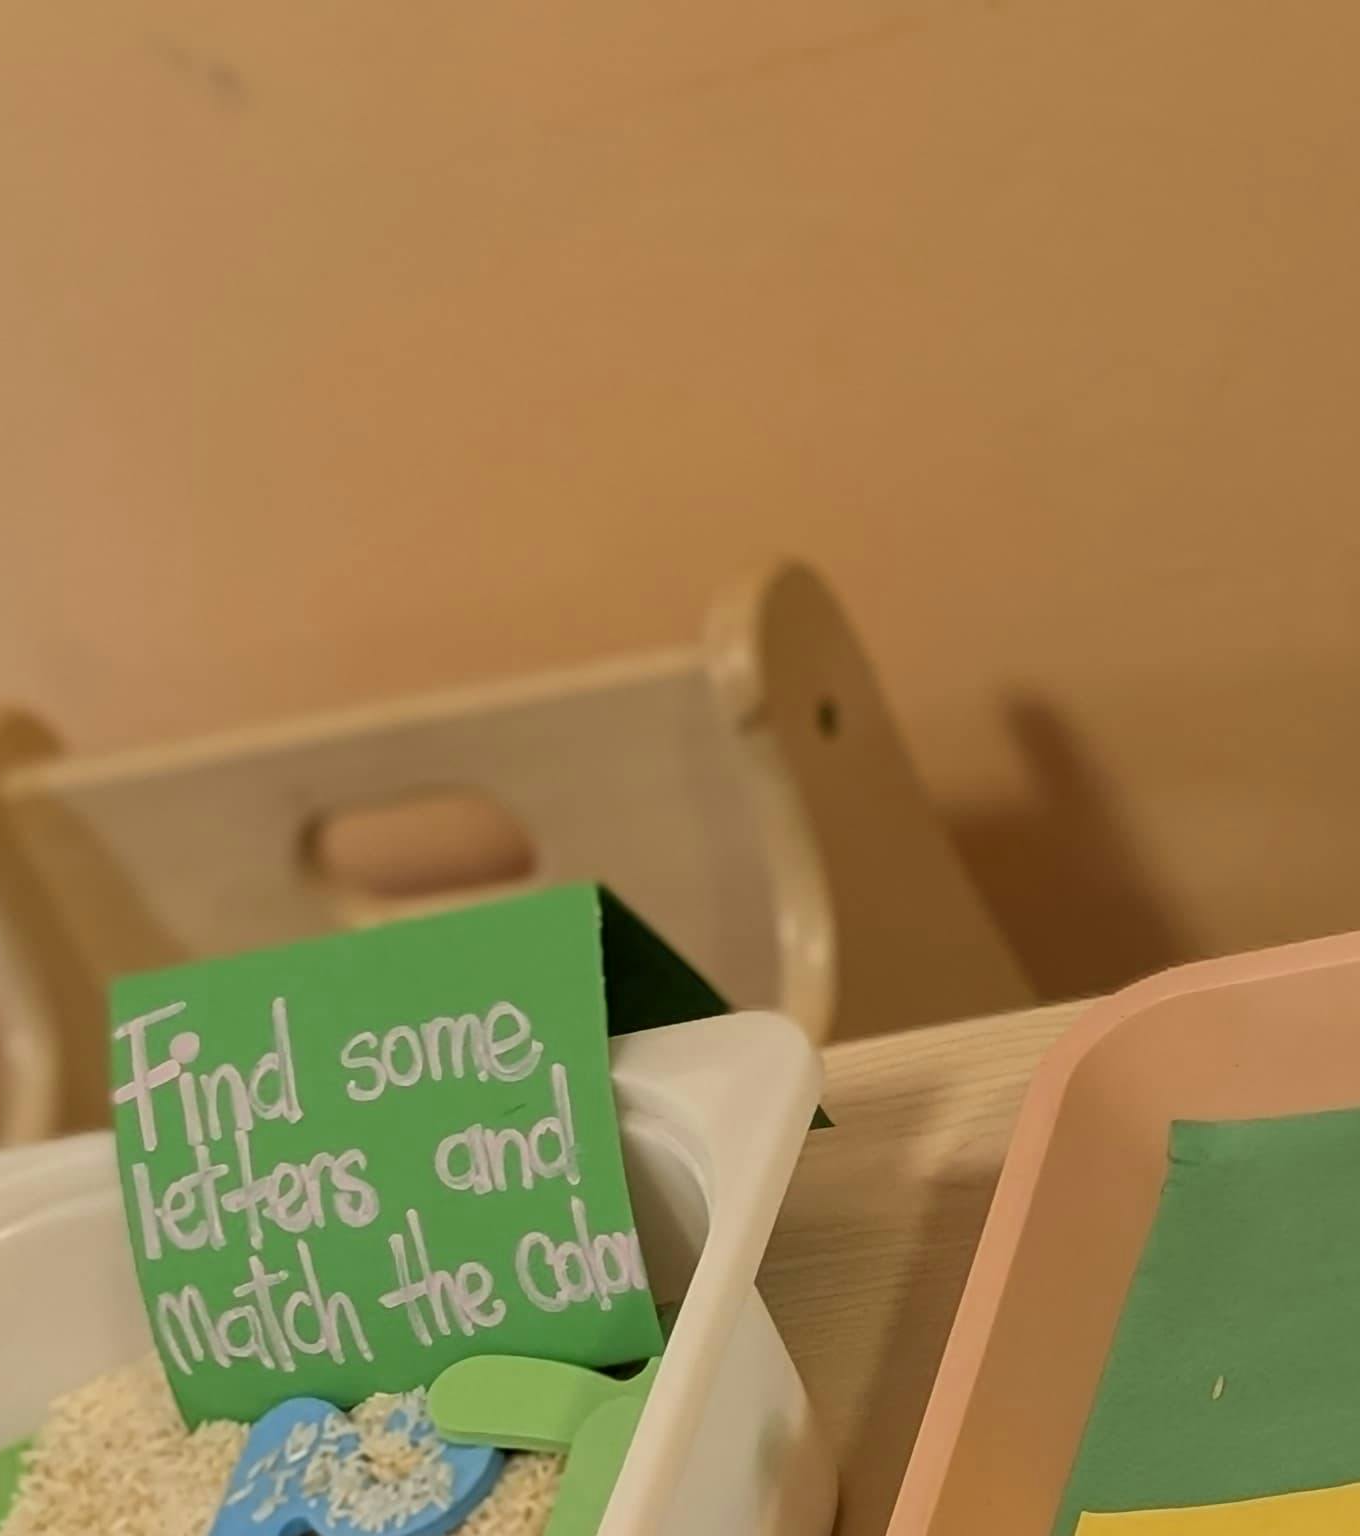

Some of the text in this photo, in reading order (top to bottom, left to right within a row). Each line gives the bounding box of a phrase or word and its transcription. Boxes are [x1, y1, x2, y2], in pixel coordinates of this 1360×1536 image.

[114, 997, 544, 1152] Find some
[132, 1063, 581, 1260] letters and
[157, 1239, 374, 1375] match
[378, 1209, 506, 1347] the
